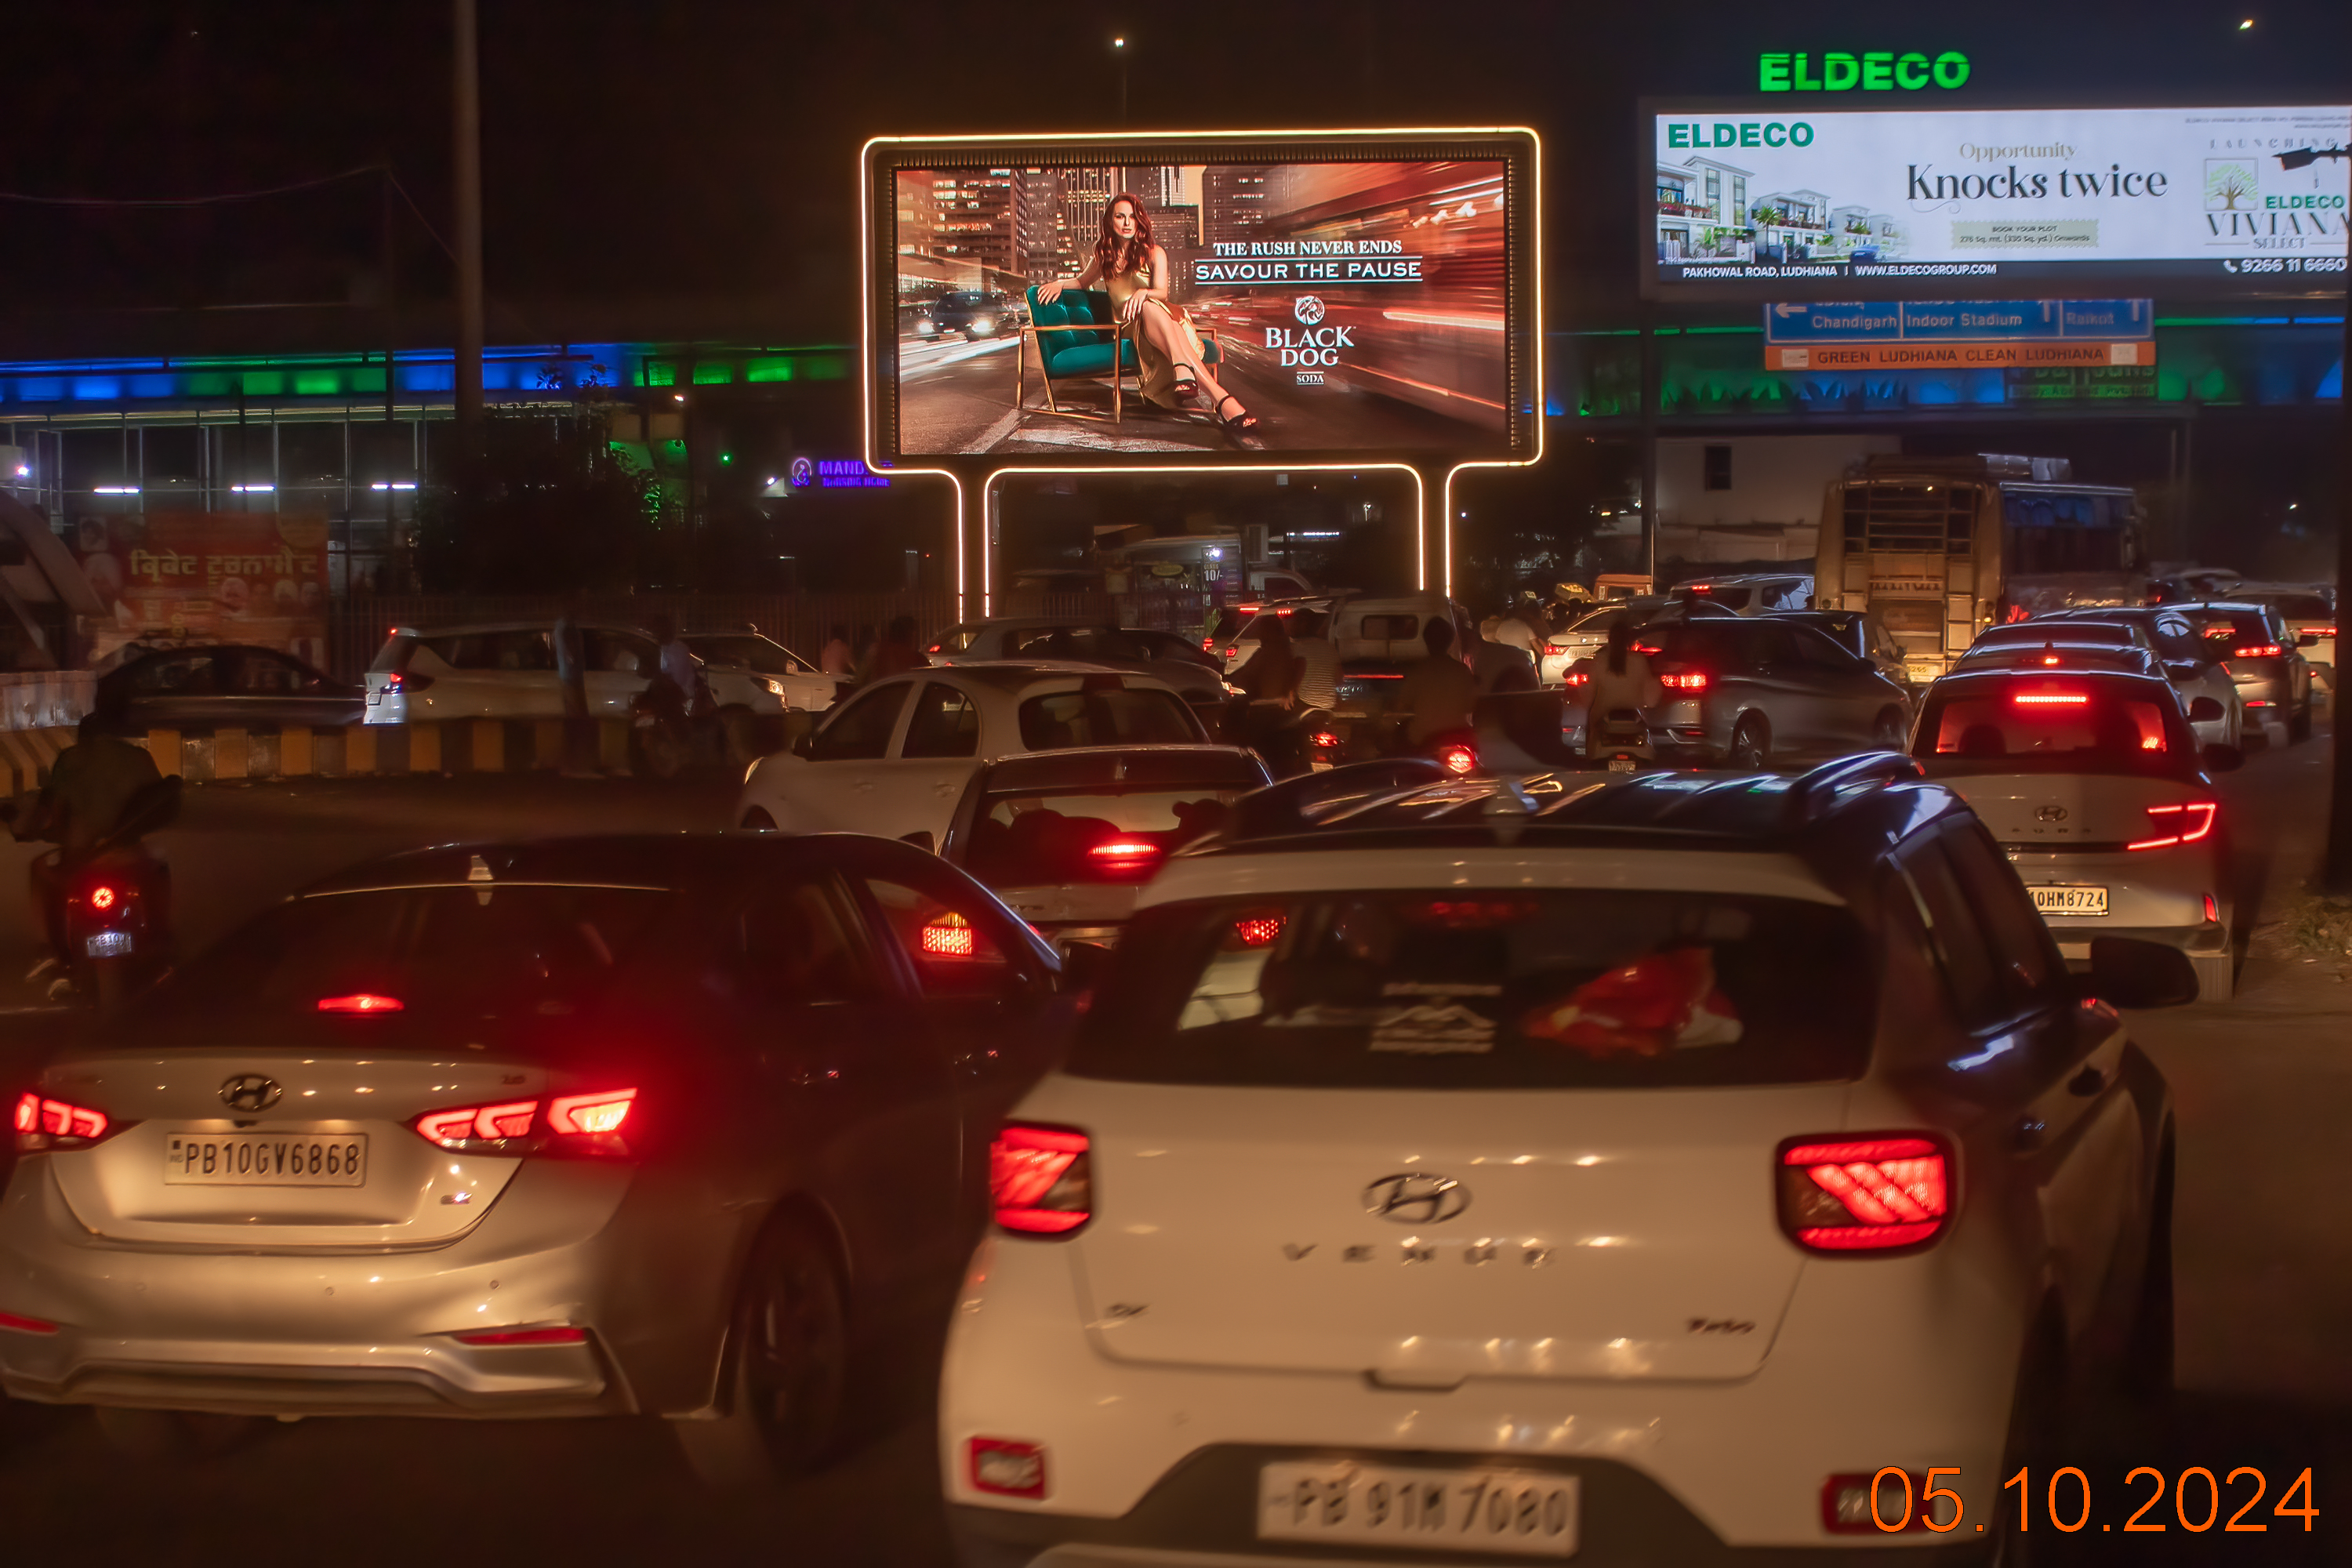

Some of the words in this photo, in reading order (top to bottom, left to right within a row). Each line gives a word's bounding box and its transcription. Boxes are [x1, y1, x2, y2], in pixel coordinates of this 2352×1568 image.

[1759, 51, 1970, 92] ELDECO
[1668, 122, 1814, 147] ELDECO
[1960, 142, 2077, 162] Opportunity
[1907, 163, 2049, 200] Knocks
[2057, 163, 2169, 198] twice
[2266, 195, 2345, 209] ELDECO
[2206, 212, 2349, 236] VIVIANA
[1213, 241, 1247, 256] THE
[1251, 241, 1296, 256] RUSH
[1299, 241, 1356, 256] NEVER
[1359, 239, 1403, 254] ENDS
[2252, 238, 2307, 249] SELECT
[1196, 263, 1288, 280] SAVOUR
[1296, 263, 1339, 278] THE
[1348, 261, 1421, 278] PAUSE
[1682, 267, 1744, 278] PAKHOWAL
[1745, 267, 1779, 278] ROAD,
[1780, 266, 1838, 278] LUDHIANA
[1855, 263, 1998, 276] WWW.ELDECOGROUP.COM
[2241, 259, 2285, 273] 9266
[2286, 259, 2301, 272] 11
[1813, 315, 1897, 331] Chandigarh
[1907, 314, 1955, 328] Indoor
[1962, 312, 2023, 326] Stadium
[1265, 326, 1355, 348] BLACK
[1280, 349, 1339, 367] DOG
[1818, 351, 1871, 365] GREEN
[1879, 350, 1958, 363] LUDHIANA
[1965, 350, 2017, 361] CLEAN
[2026, 348, 2105, 361] LUDHIANA
[1296, 374, 1324, 385] SODA
[819, 460, 869, 475] MAND
[2028, 891, 2104, 907] 10HM8724
[185, 1141, 361, 1176] PB10GV6868
[1282, 1242, 1557, 1269] VENUE
[1294, 1476, 1350, 1527] PB
[1460, 1474, 1568, 1537] 7080
